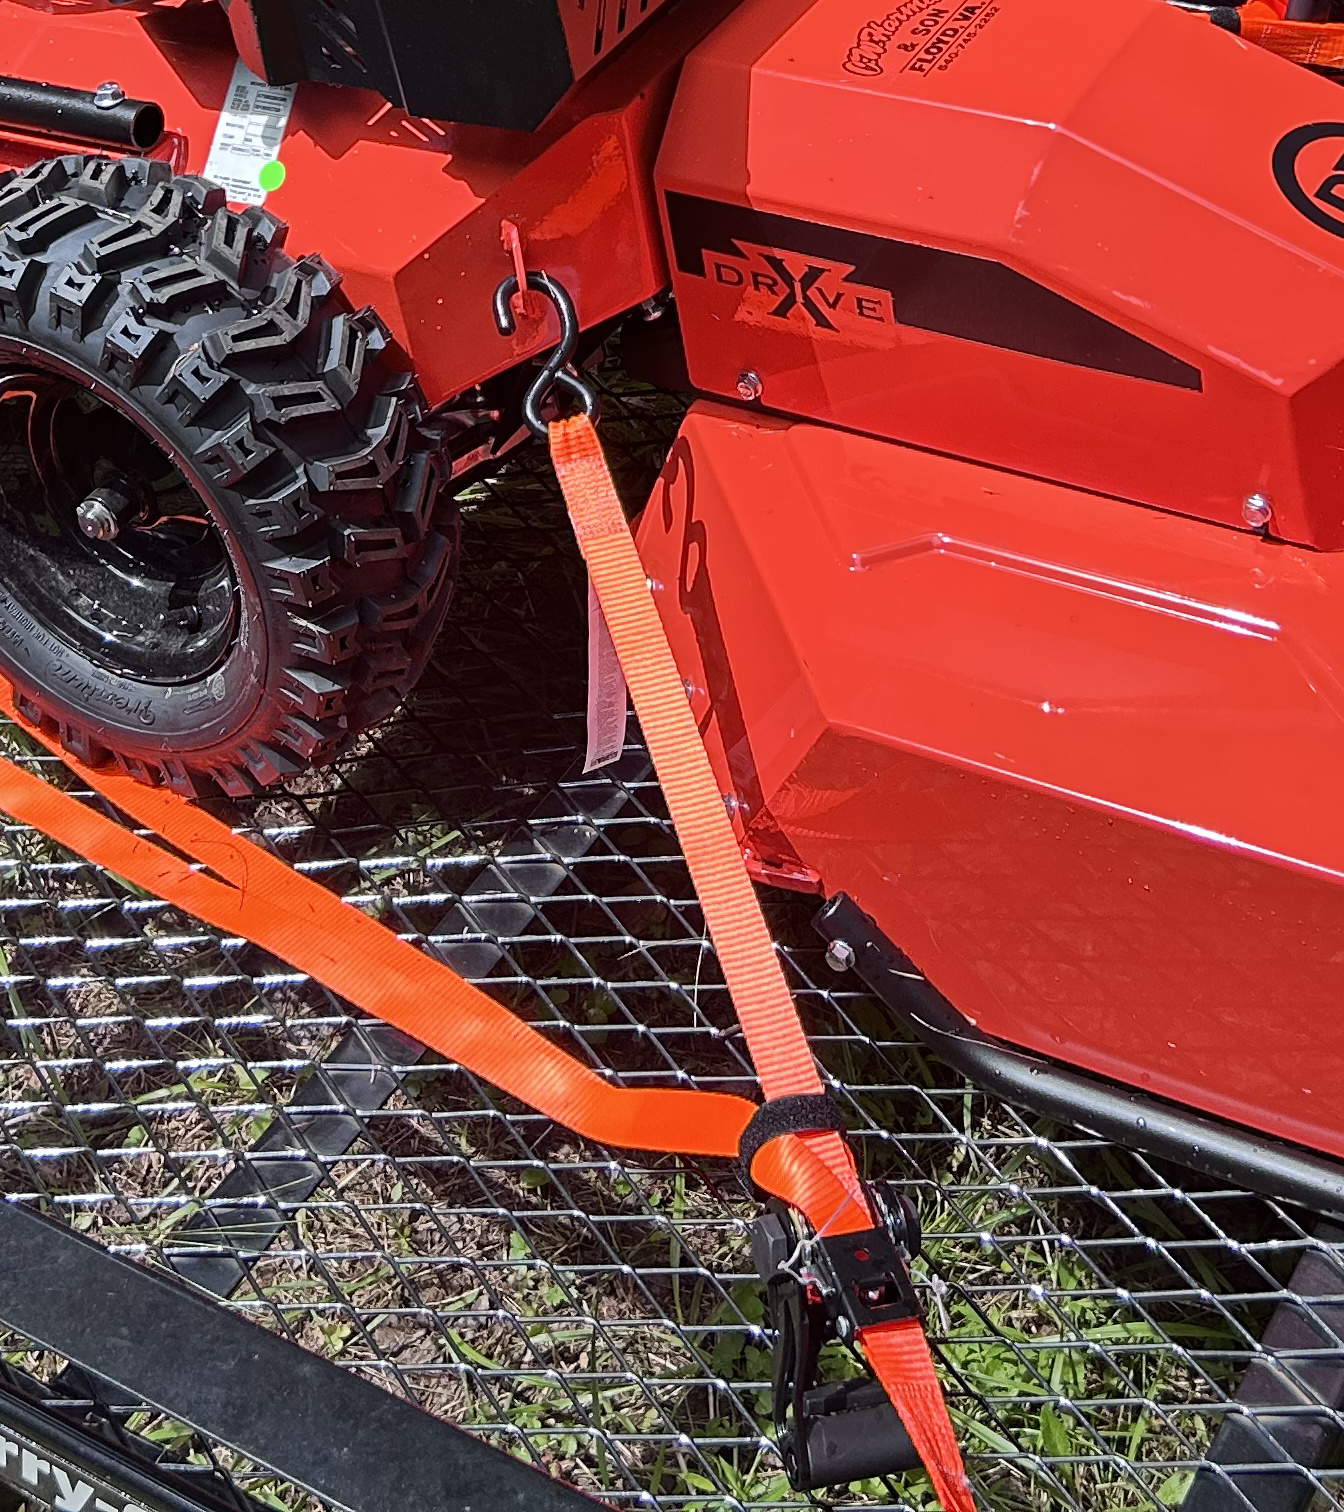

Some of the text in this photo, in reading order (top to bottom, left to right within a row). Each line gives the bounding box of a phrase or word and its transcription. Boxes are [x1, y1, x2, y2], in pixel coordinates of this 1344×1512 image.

[896, 7, 950, 53] & SON
[908, 1, 987, 73] FLOYD, VA.
